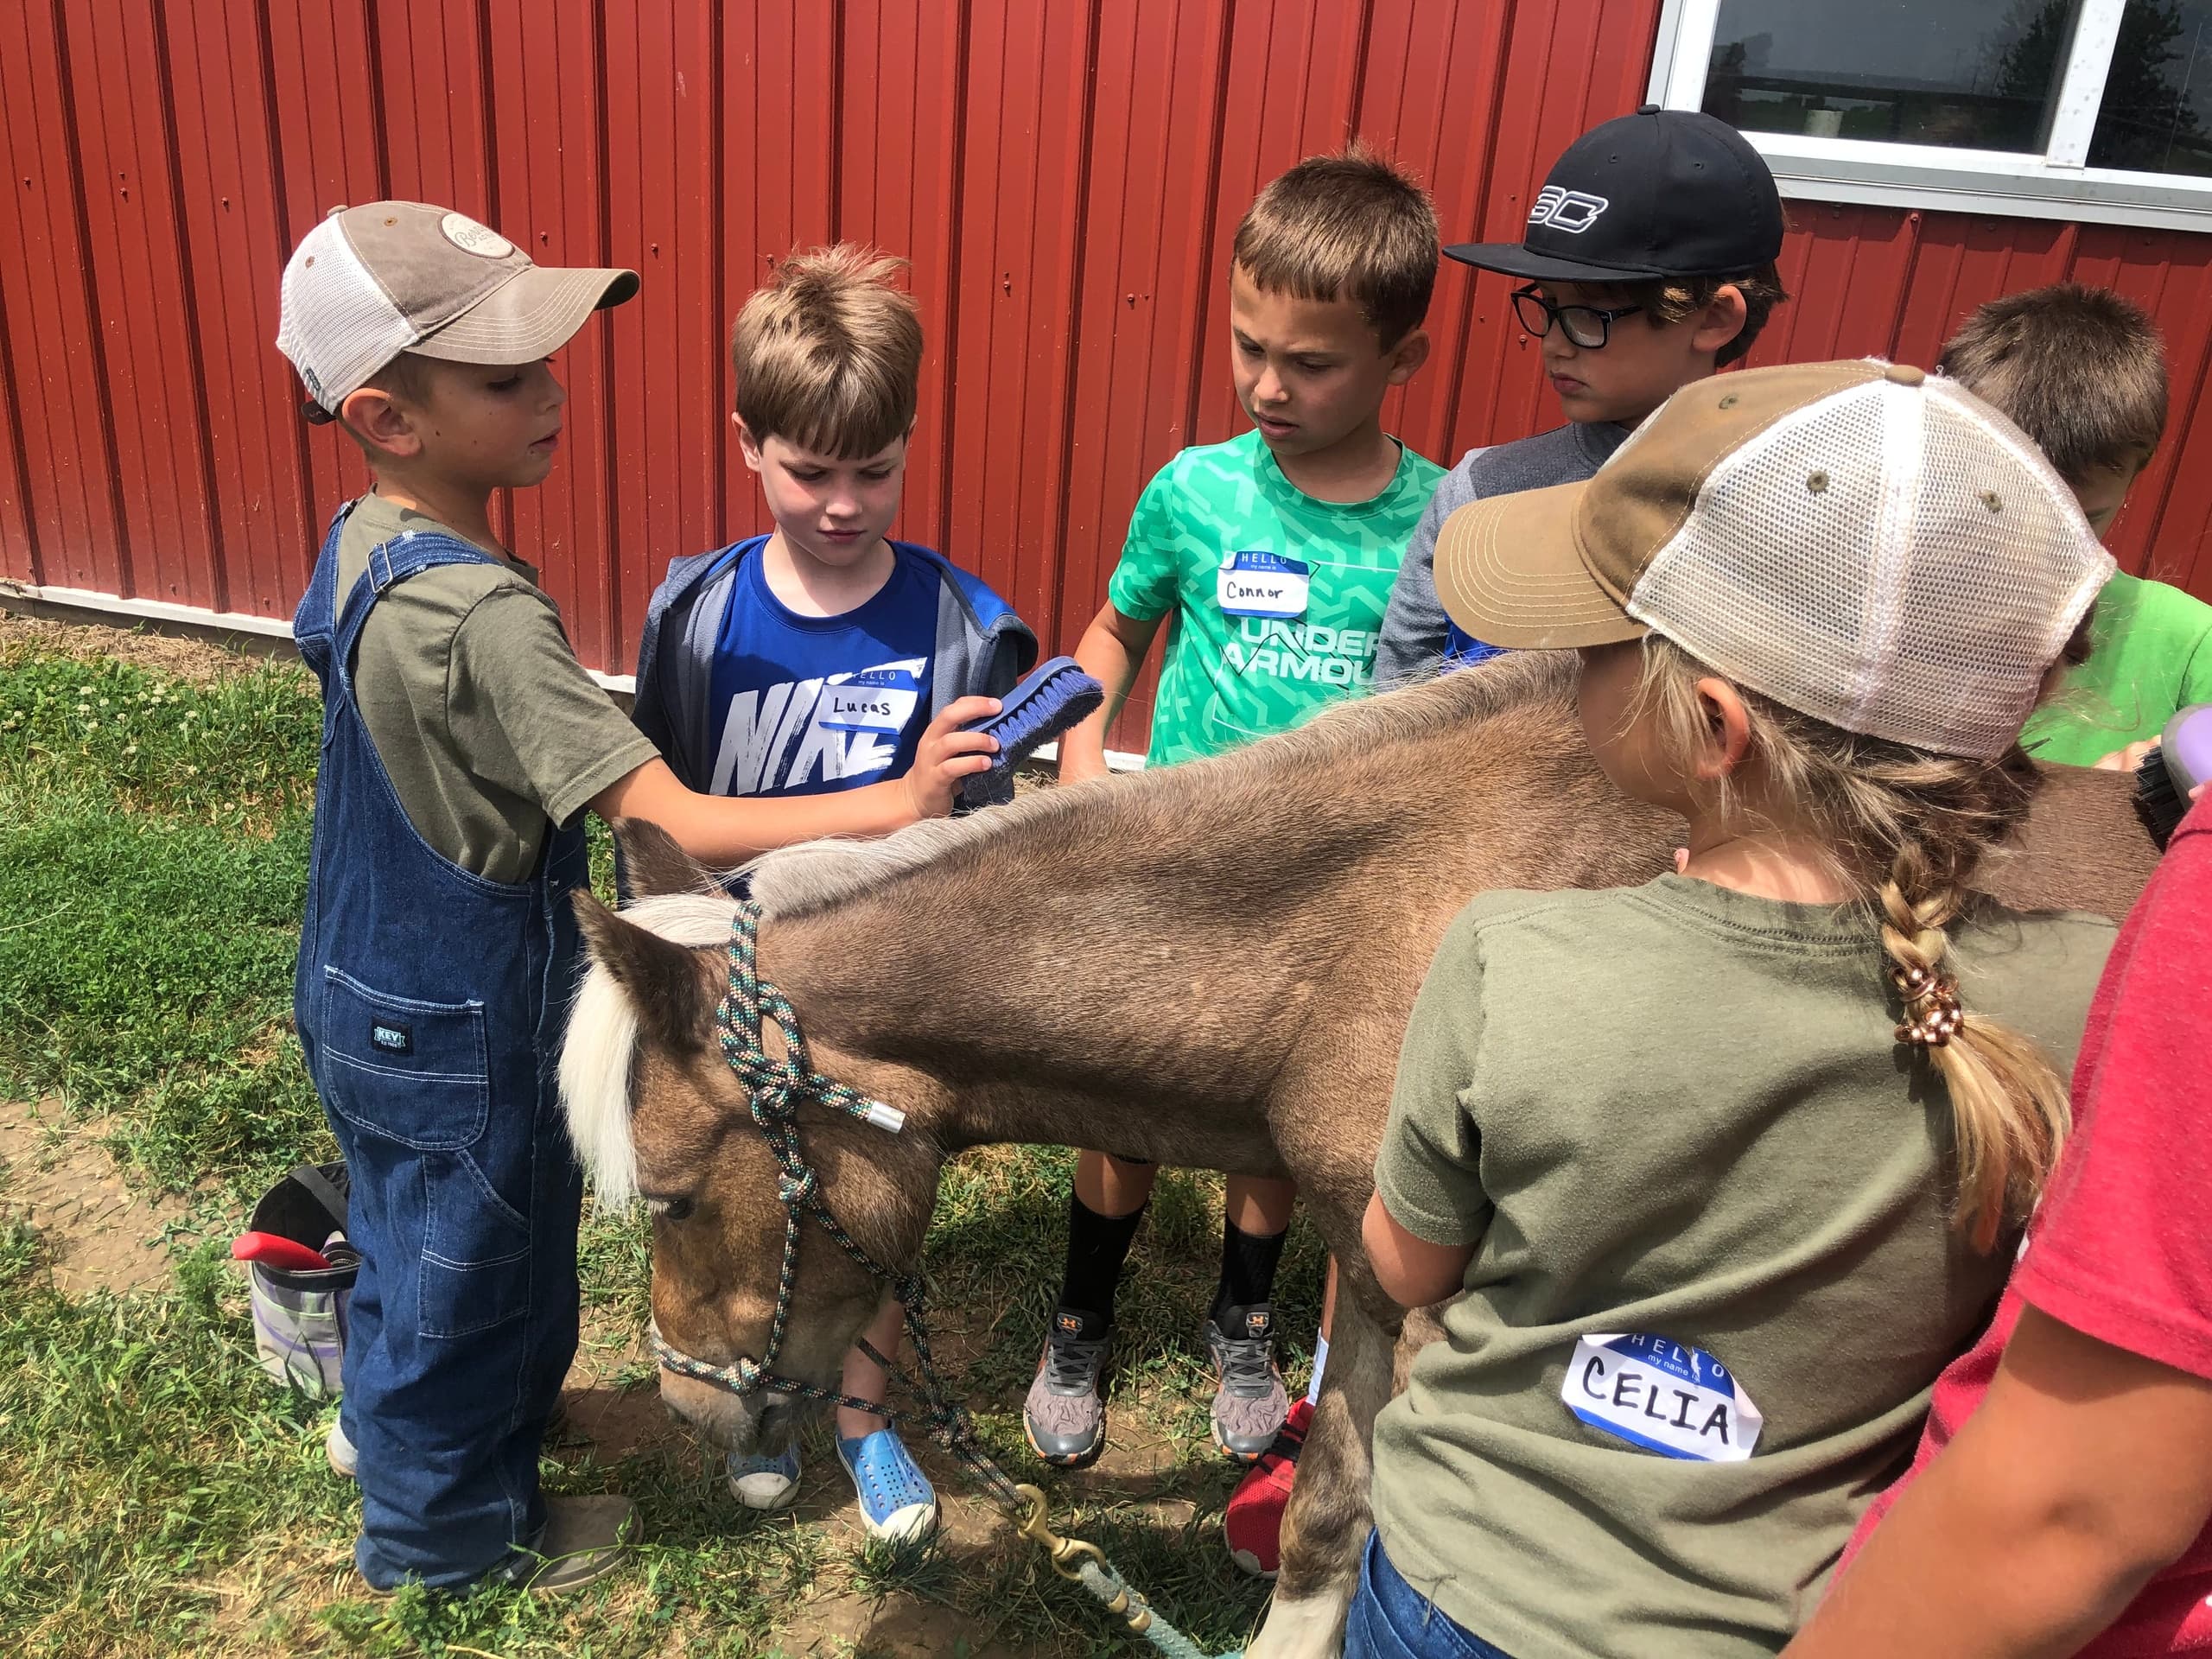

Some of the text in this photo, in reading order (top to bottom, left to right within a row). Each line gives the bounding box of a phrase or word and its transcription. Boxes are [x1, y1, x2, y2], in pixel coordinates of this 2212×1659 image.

[1242, 553, 1287, 564] HELLO
[1227, 582, 1283, 599] Connor
[1222, 642, 1376, 685] ARMOU
[853, 671, 896, 681] ELLO
[833, 697, 891, 715] Lucas
[378, 1028, 398, 1041] KEY
[1648, 1354, 1662, 1365] my
[1663, 1360, 1688, 1376] name
[1583, 1356, 1730, 1445] CELIA
